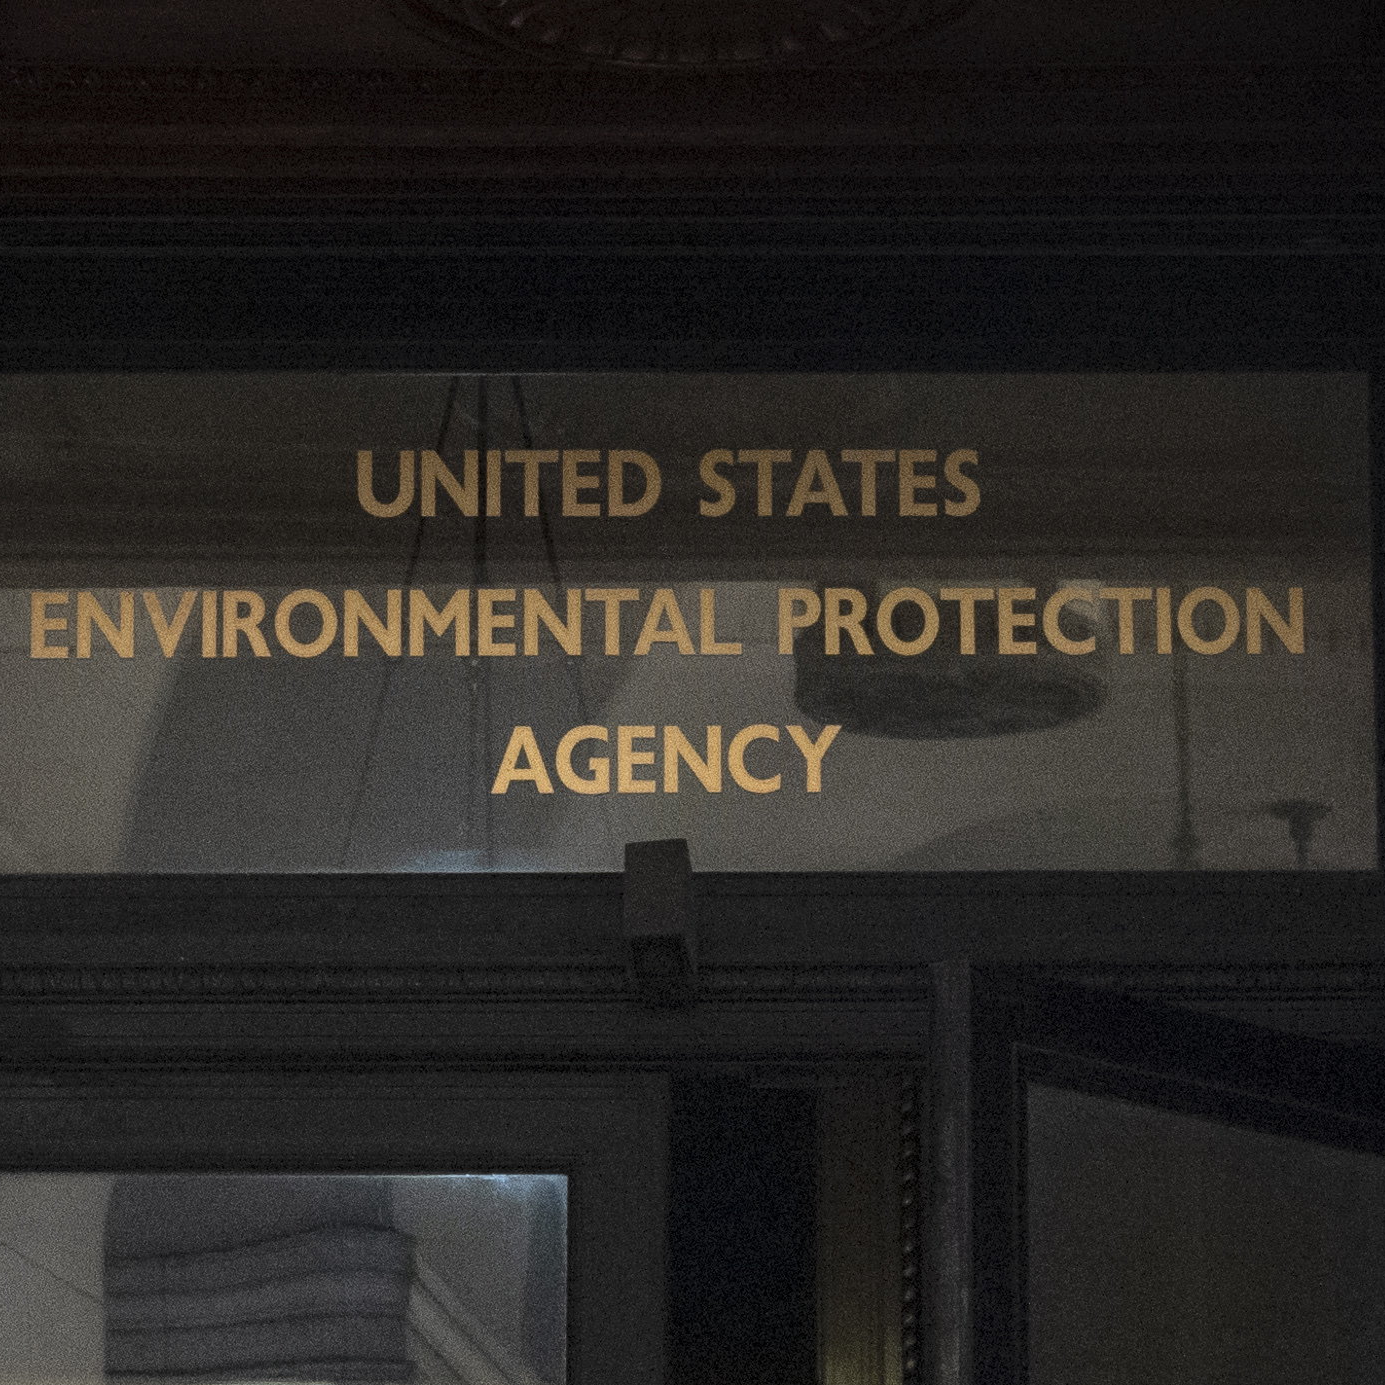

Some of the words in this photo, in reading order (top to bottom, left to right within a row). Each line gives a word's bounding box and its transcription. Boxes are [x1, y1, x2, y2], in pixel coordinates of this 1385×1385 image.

[357, 450, 661, 518] UNITED
[700, 450, 981, 517] STATES
[30, 587, 743, 660] ENVIRONMENTAL
[778, 585, 1304, 658] PROTECTION
[491, 723, 841, 796] AGENCY
